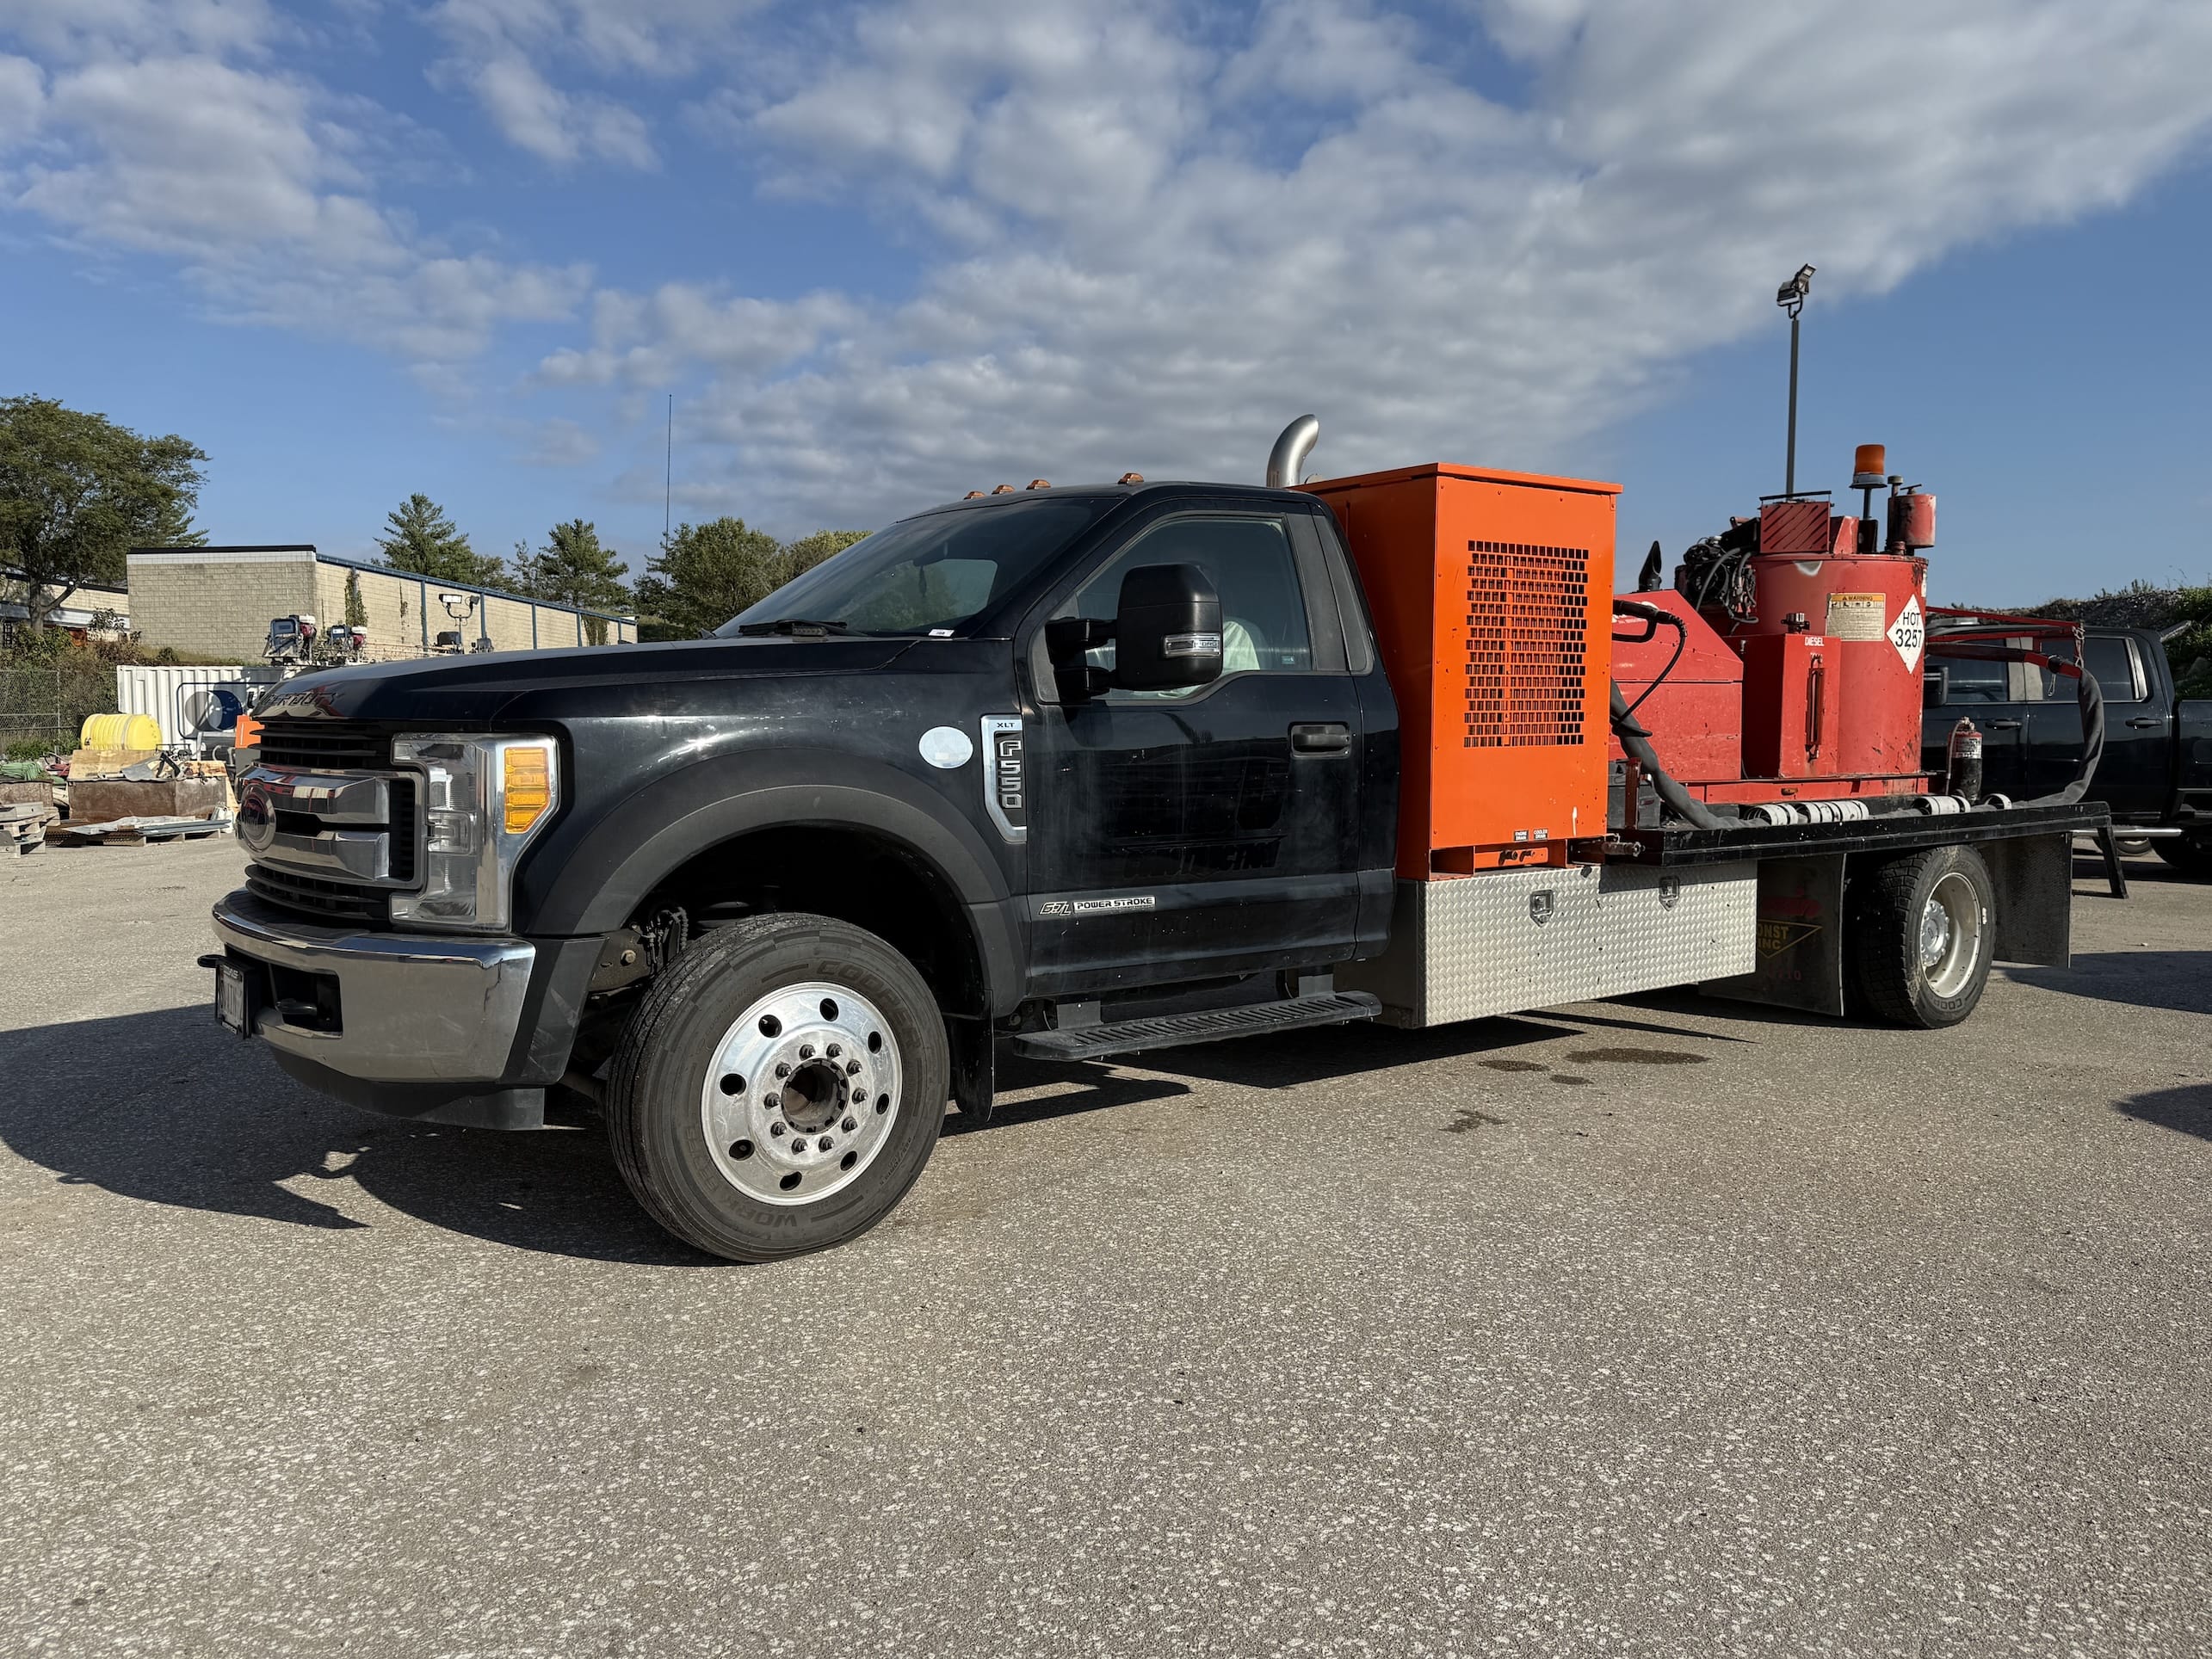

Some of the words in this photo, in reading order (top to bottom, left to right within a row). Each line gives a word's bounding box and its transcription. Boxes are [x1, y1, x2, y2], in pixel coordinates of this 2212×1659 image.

[1902, 612, 1921, 626] HOT
[1804, 637, 1825, 646] DIESEL
[1895, 628, 1922, 648] 3257
[998, 739, 1023, 809] F550
[1039, 901, 1072, 916] 6.7L
[1077, 901, 1112, 910] POWER
[1114, 897, 1153, 907] STROKE
[1757, 923, 1789, 940] ONST
[818, 959, 922, 1049] COOPER
